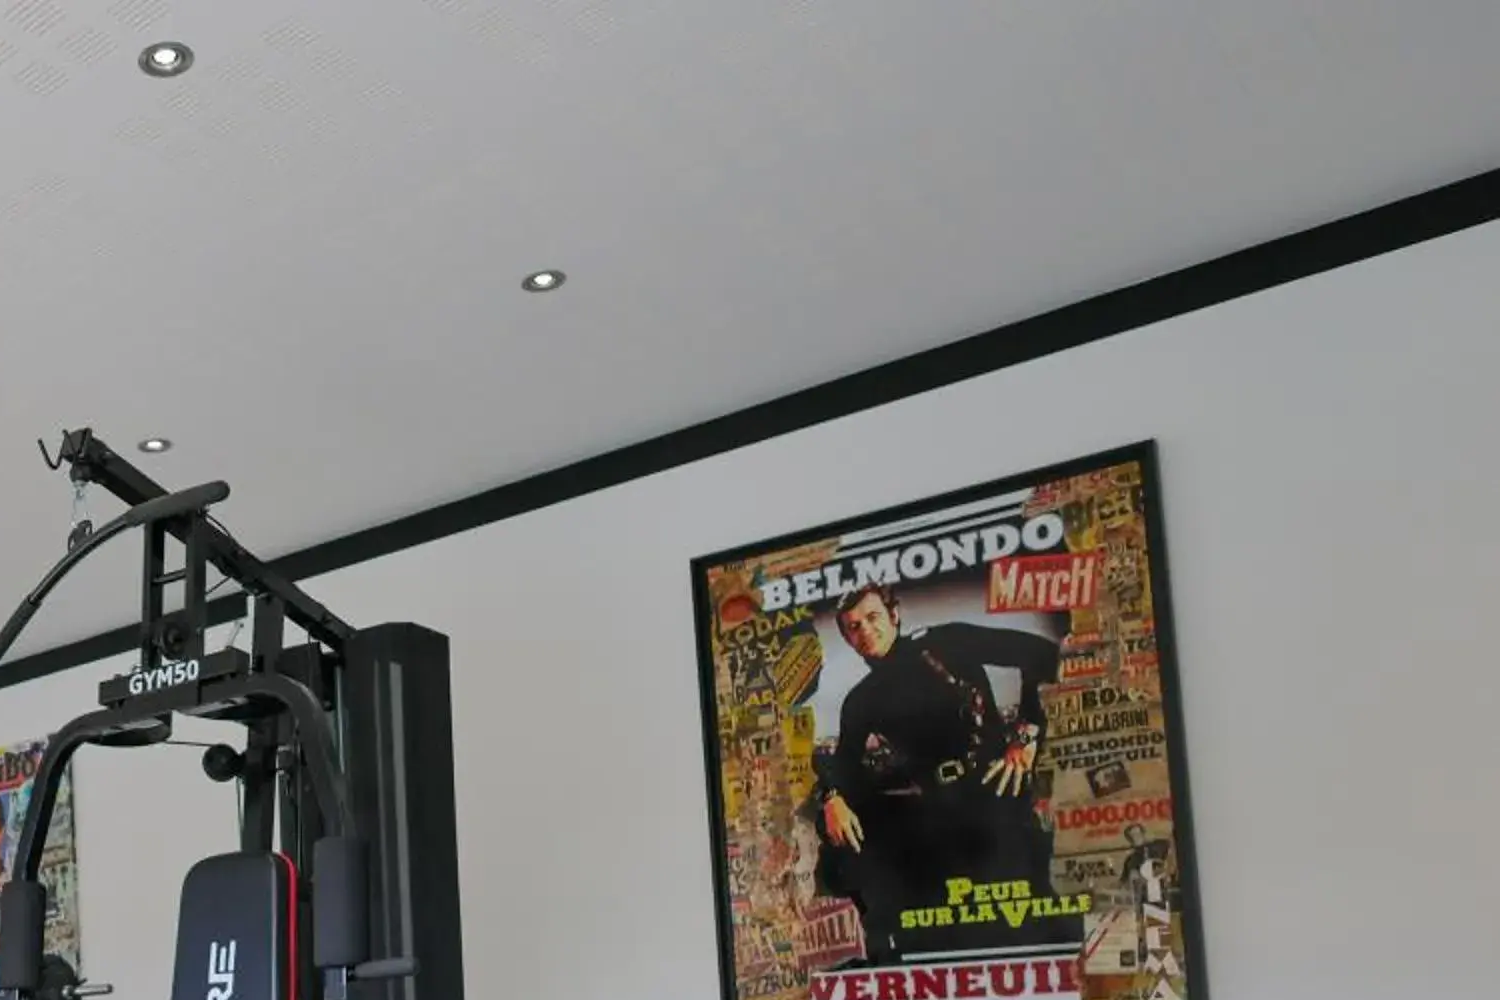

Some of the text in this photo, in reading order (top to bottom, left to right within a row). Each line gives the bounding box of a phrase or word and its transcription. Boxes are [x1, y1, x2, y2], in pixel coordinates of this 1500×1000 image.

[761, 511, 1064, 611] BELMONDO
[989, 555, 1094, 611] MATCH
[128, 659, 199, 695] GYM50
[945, 877, 1031, 905] PEUR
[900, 894, 1092, 929] SUR LA VILLE
